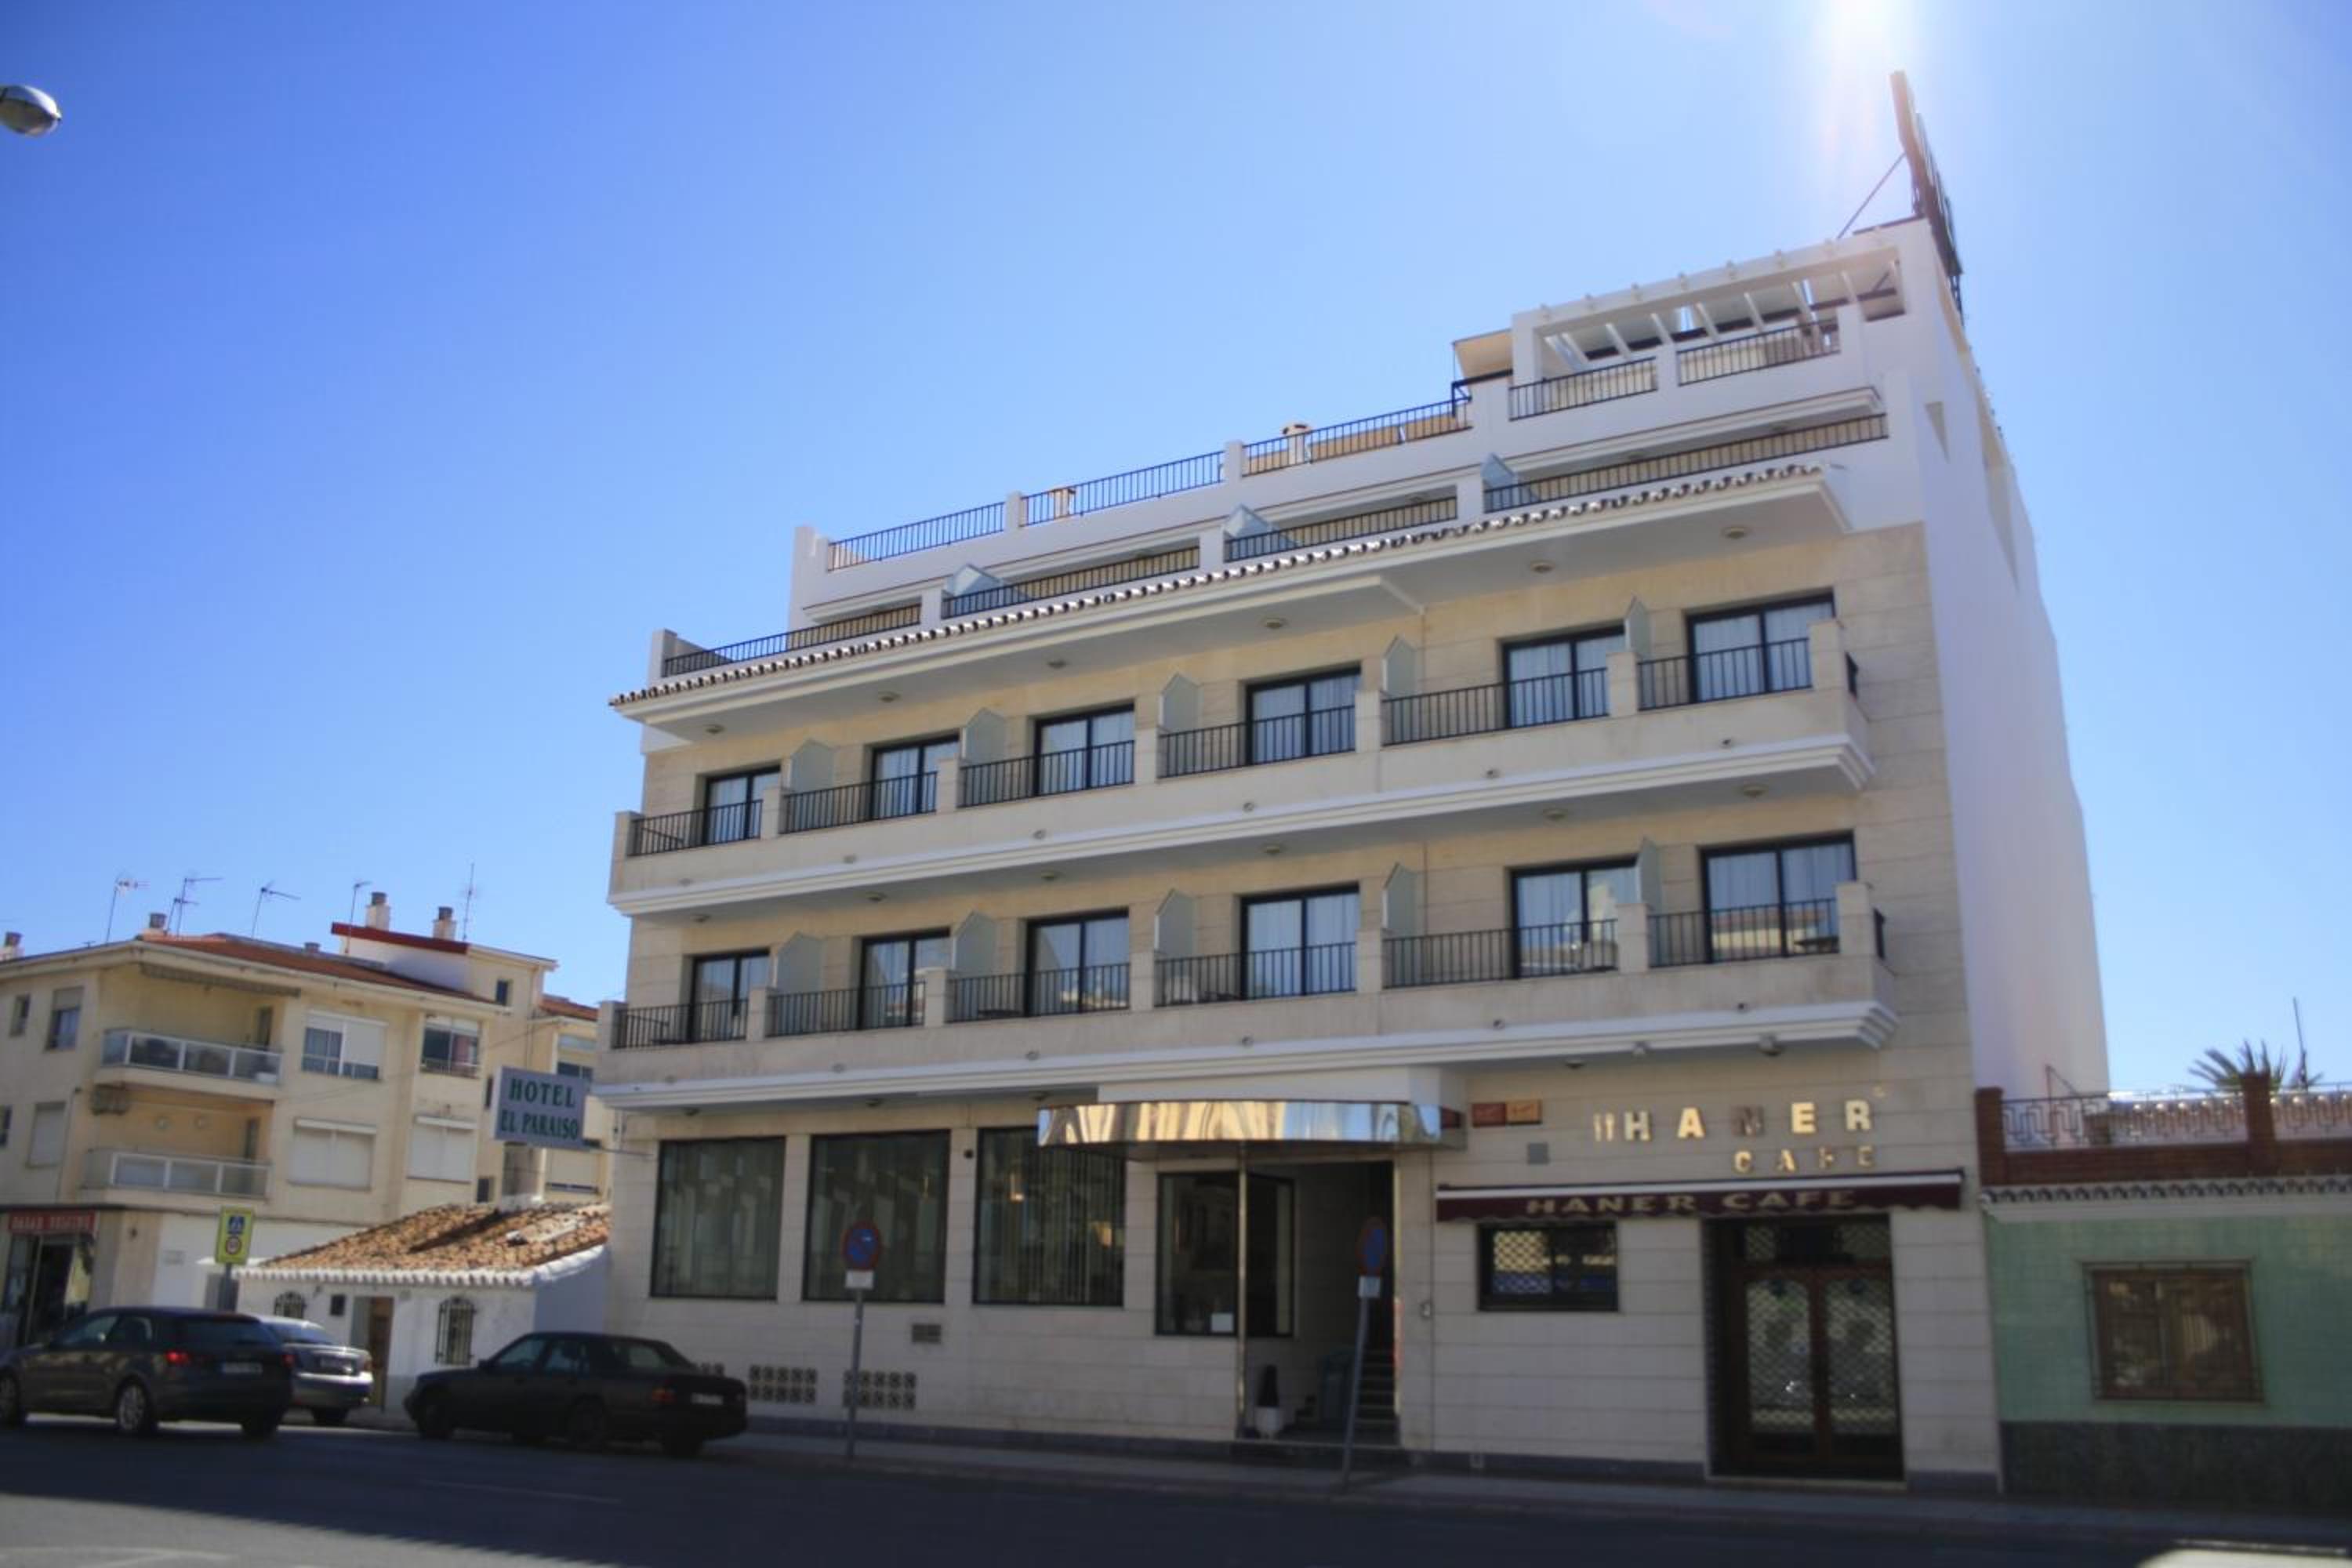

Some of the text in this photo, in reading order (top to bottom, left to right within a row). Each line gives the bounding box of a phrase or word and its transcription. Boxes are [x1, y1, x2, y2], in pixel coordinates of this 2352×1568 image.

[509, 1078, 576, 1108] HOTEL
[501, 1109, 578, 1142] EL PARAISO
[1526, 1190, 1856, 1214] HANER CAFE
